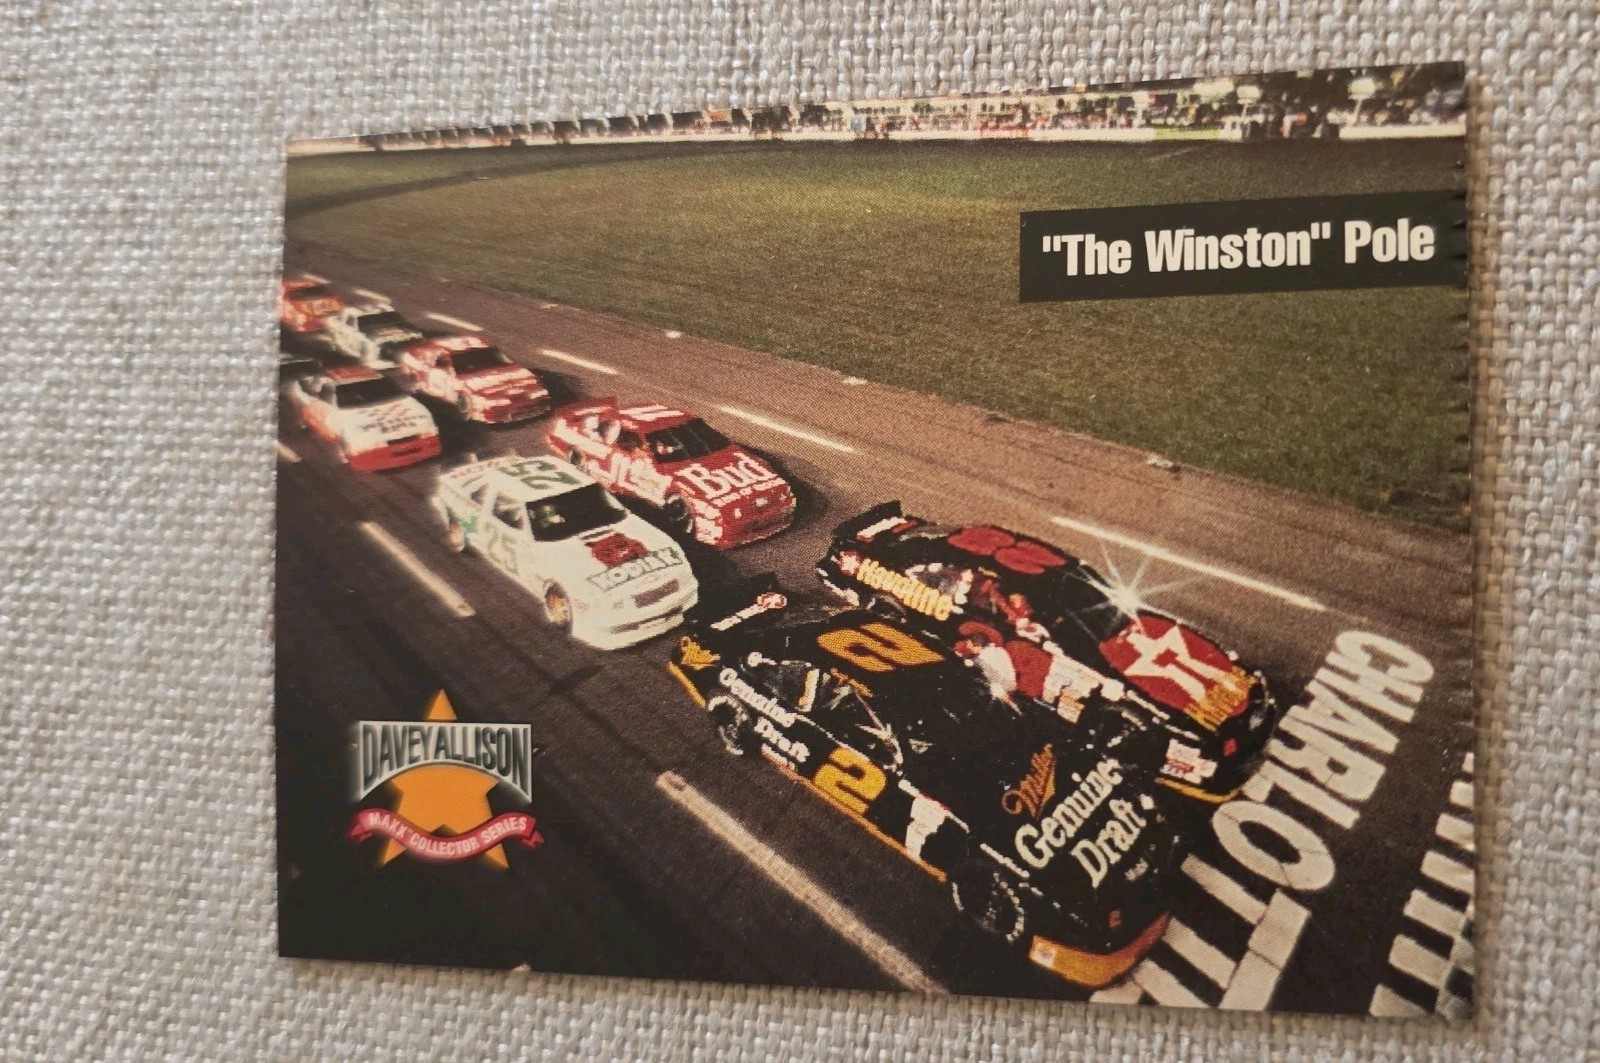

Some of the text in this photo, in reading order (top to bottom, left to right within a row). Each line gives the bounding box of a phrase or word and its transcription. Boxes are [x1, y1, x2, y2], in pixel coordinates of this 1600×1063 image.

[1042, 217, 1435, 277] "The Winston" Pole
[676, 452, 778, 499] Bud
[362, 724, 529, 800] DAVEY ALLISON
[814, 745, 887, 814] 2
[410, 831, 479, 856] COLLECTOR
[482, 816, 528, 844] SERIES
[1015, 757, 1124, 869] Genuine
[1070, 798, 1148, 888] Draft
